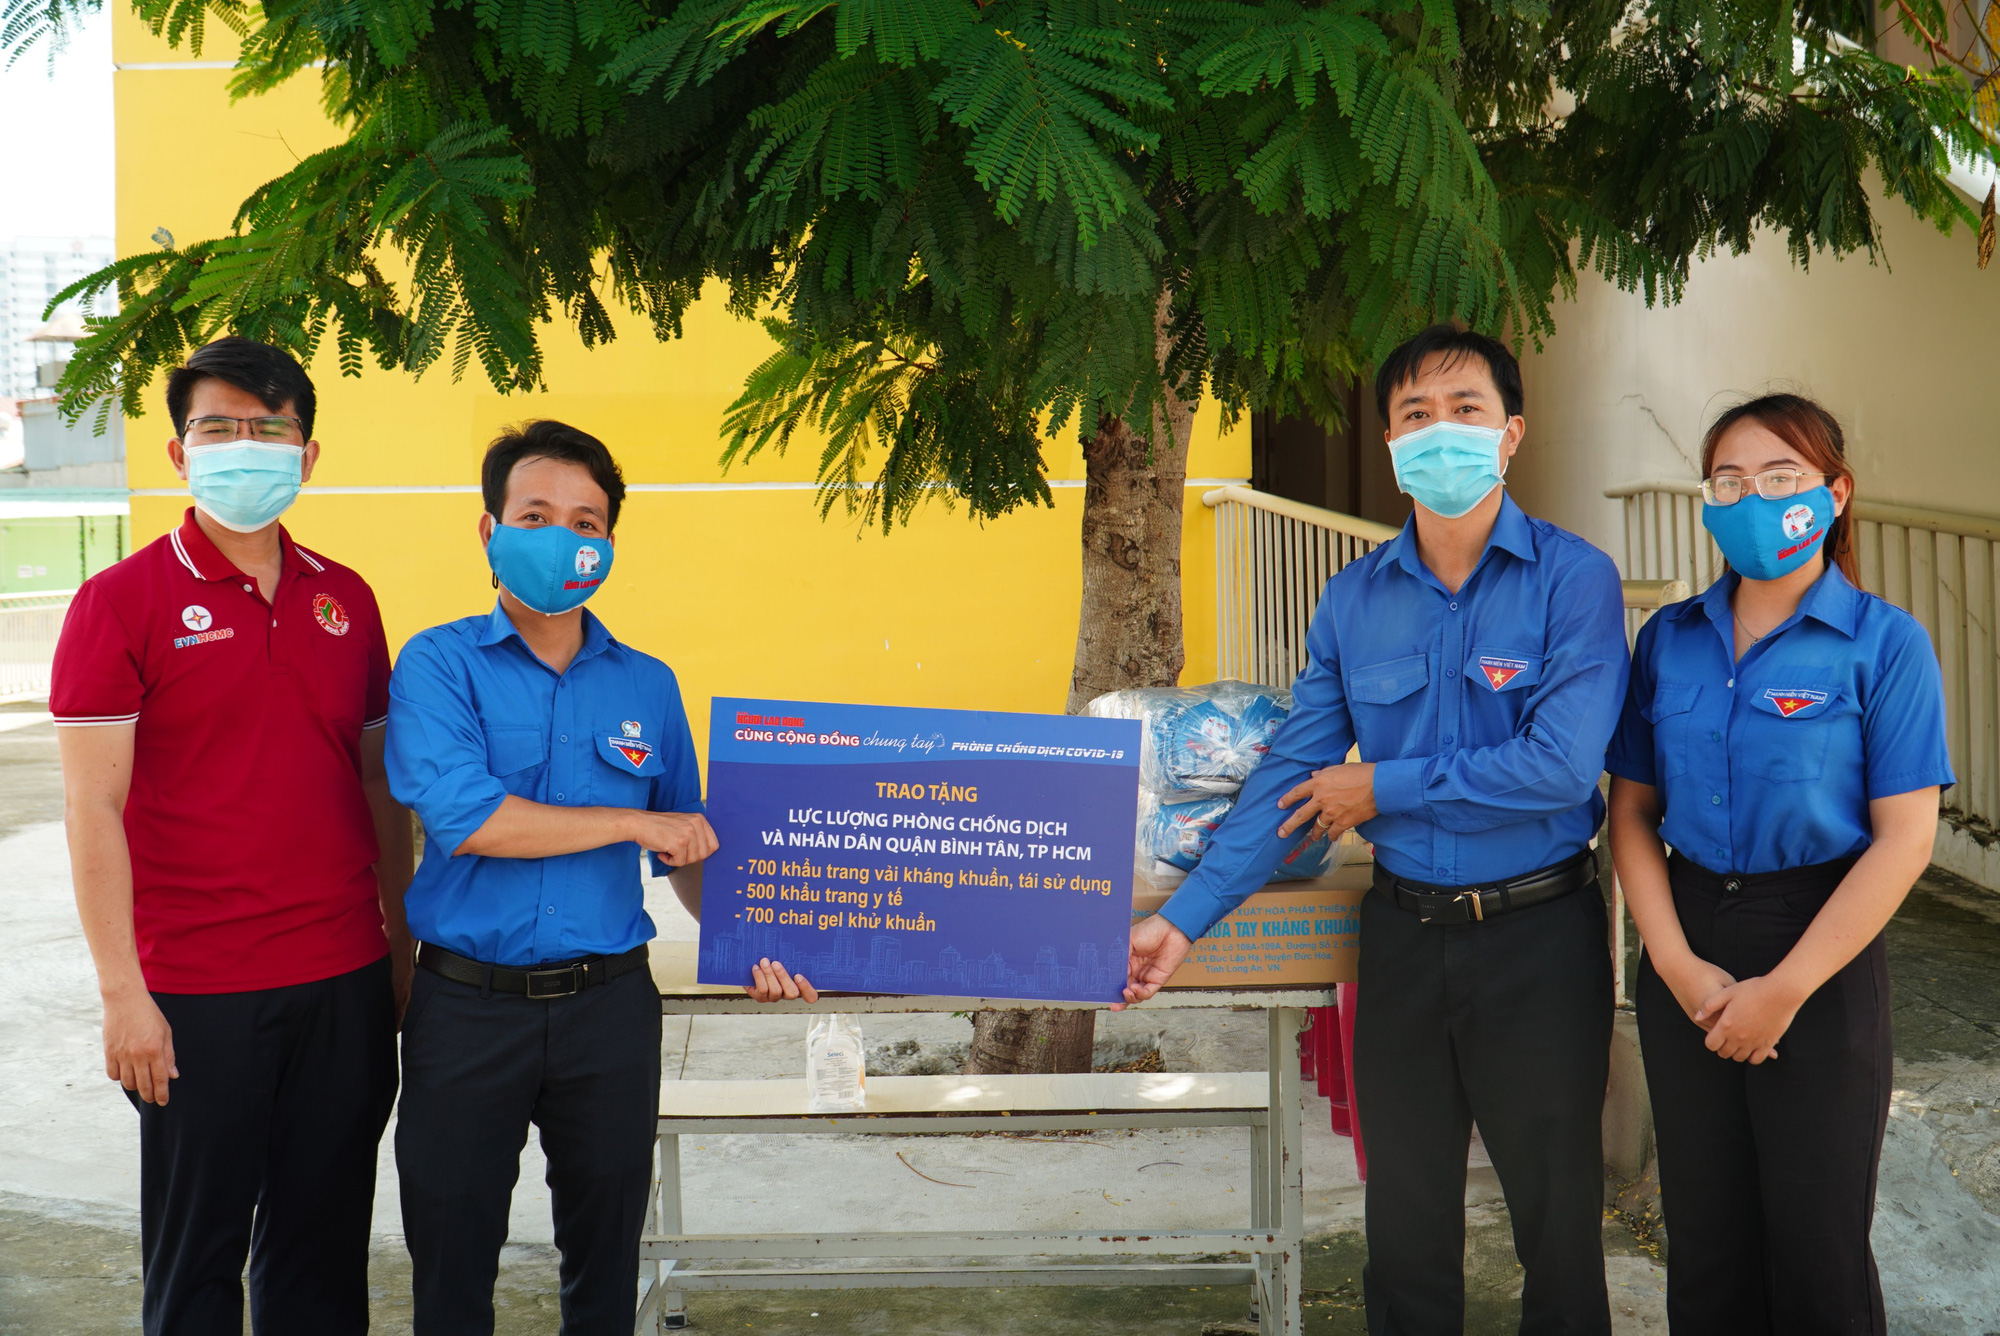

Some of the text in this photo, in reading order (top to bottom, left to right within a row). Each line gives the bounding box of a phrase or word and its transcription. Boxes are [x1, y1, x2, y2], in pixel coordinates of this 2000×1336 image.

[174, 628, 234, 649] EVNHCMC
[735, 727, 1124, 760] CÙNG CỘNG ĐỒNG chung tay PHÒNG CHỐNG DỊCH COVID-19
[876, 782, 978, 806] TRAO TẶNG
[788, 808, 1068, 839] LỰC LƯỢNG PHÒNG CHỐNG DỊCH
[761, 829, 1092, 861] VÀ NHÂN DÂN QUẬN BÌNH TÂN, TP HCM
[748, 859, 776, 876] 700
[782, 858, 821, 878] khẩu
[826, 864, 870, 884] trang
[874, 865, 898, 882] vải
[903, 867, 954, 888] kháng
[958, 867, 1014, 890] khuẩn,
[1018, 872, 1038, 889] tái
[1043, 874, 1066, 890] sử
[1070, 875, 1112, 896] dụng
[746, 883, 776, 900] 500
[780, 882, 820, 902] khẩu
[825, 888, 868, 908] trang
[872, 894, 883, 910] y
[888, 887, 903, 906] tế
[746, 907, 774, 924] 700
[779, 909, 814, 926] chai
[818, 912, 844, 930] gel
[848, 912, 882, 928] khử
[886, 912, 936, 932] khuẩn
[1131, 908, 1151, 918] ÔNG
[1318, 904, 1347, 913] THIÊN
[1235, 922, 1258, 938] TAY
[1262, 918, 1310, 937] KHÁNG
[1314, 912, 1361, 935] KHUẨN
[1230, 954, 1246, 964] Lập
[1264, 953, 1292, 963] Huyện
[1294, 952, 1312, 960] Đức
[1286, 942, 1316, 951] Đường
[1319, 940, 1330, 949] Số
[1226, 965, 1249, 974] Long
